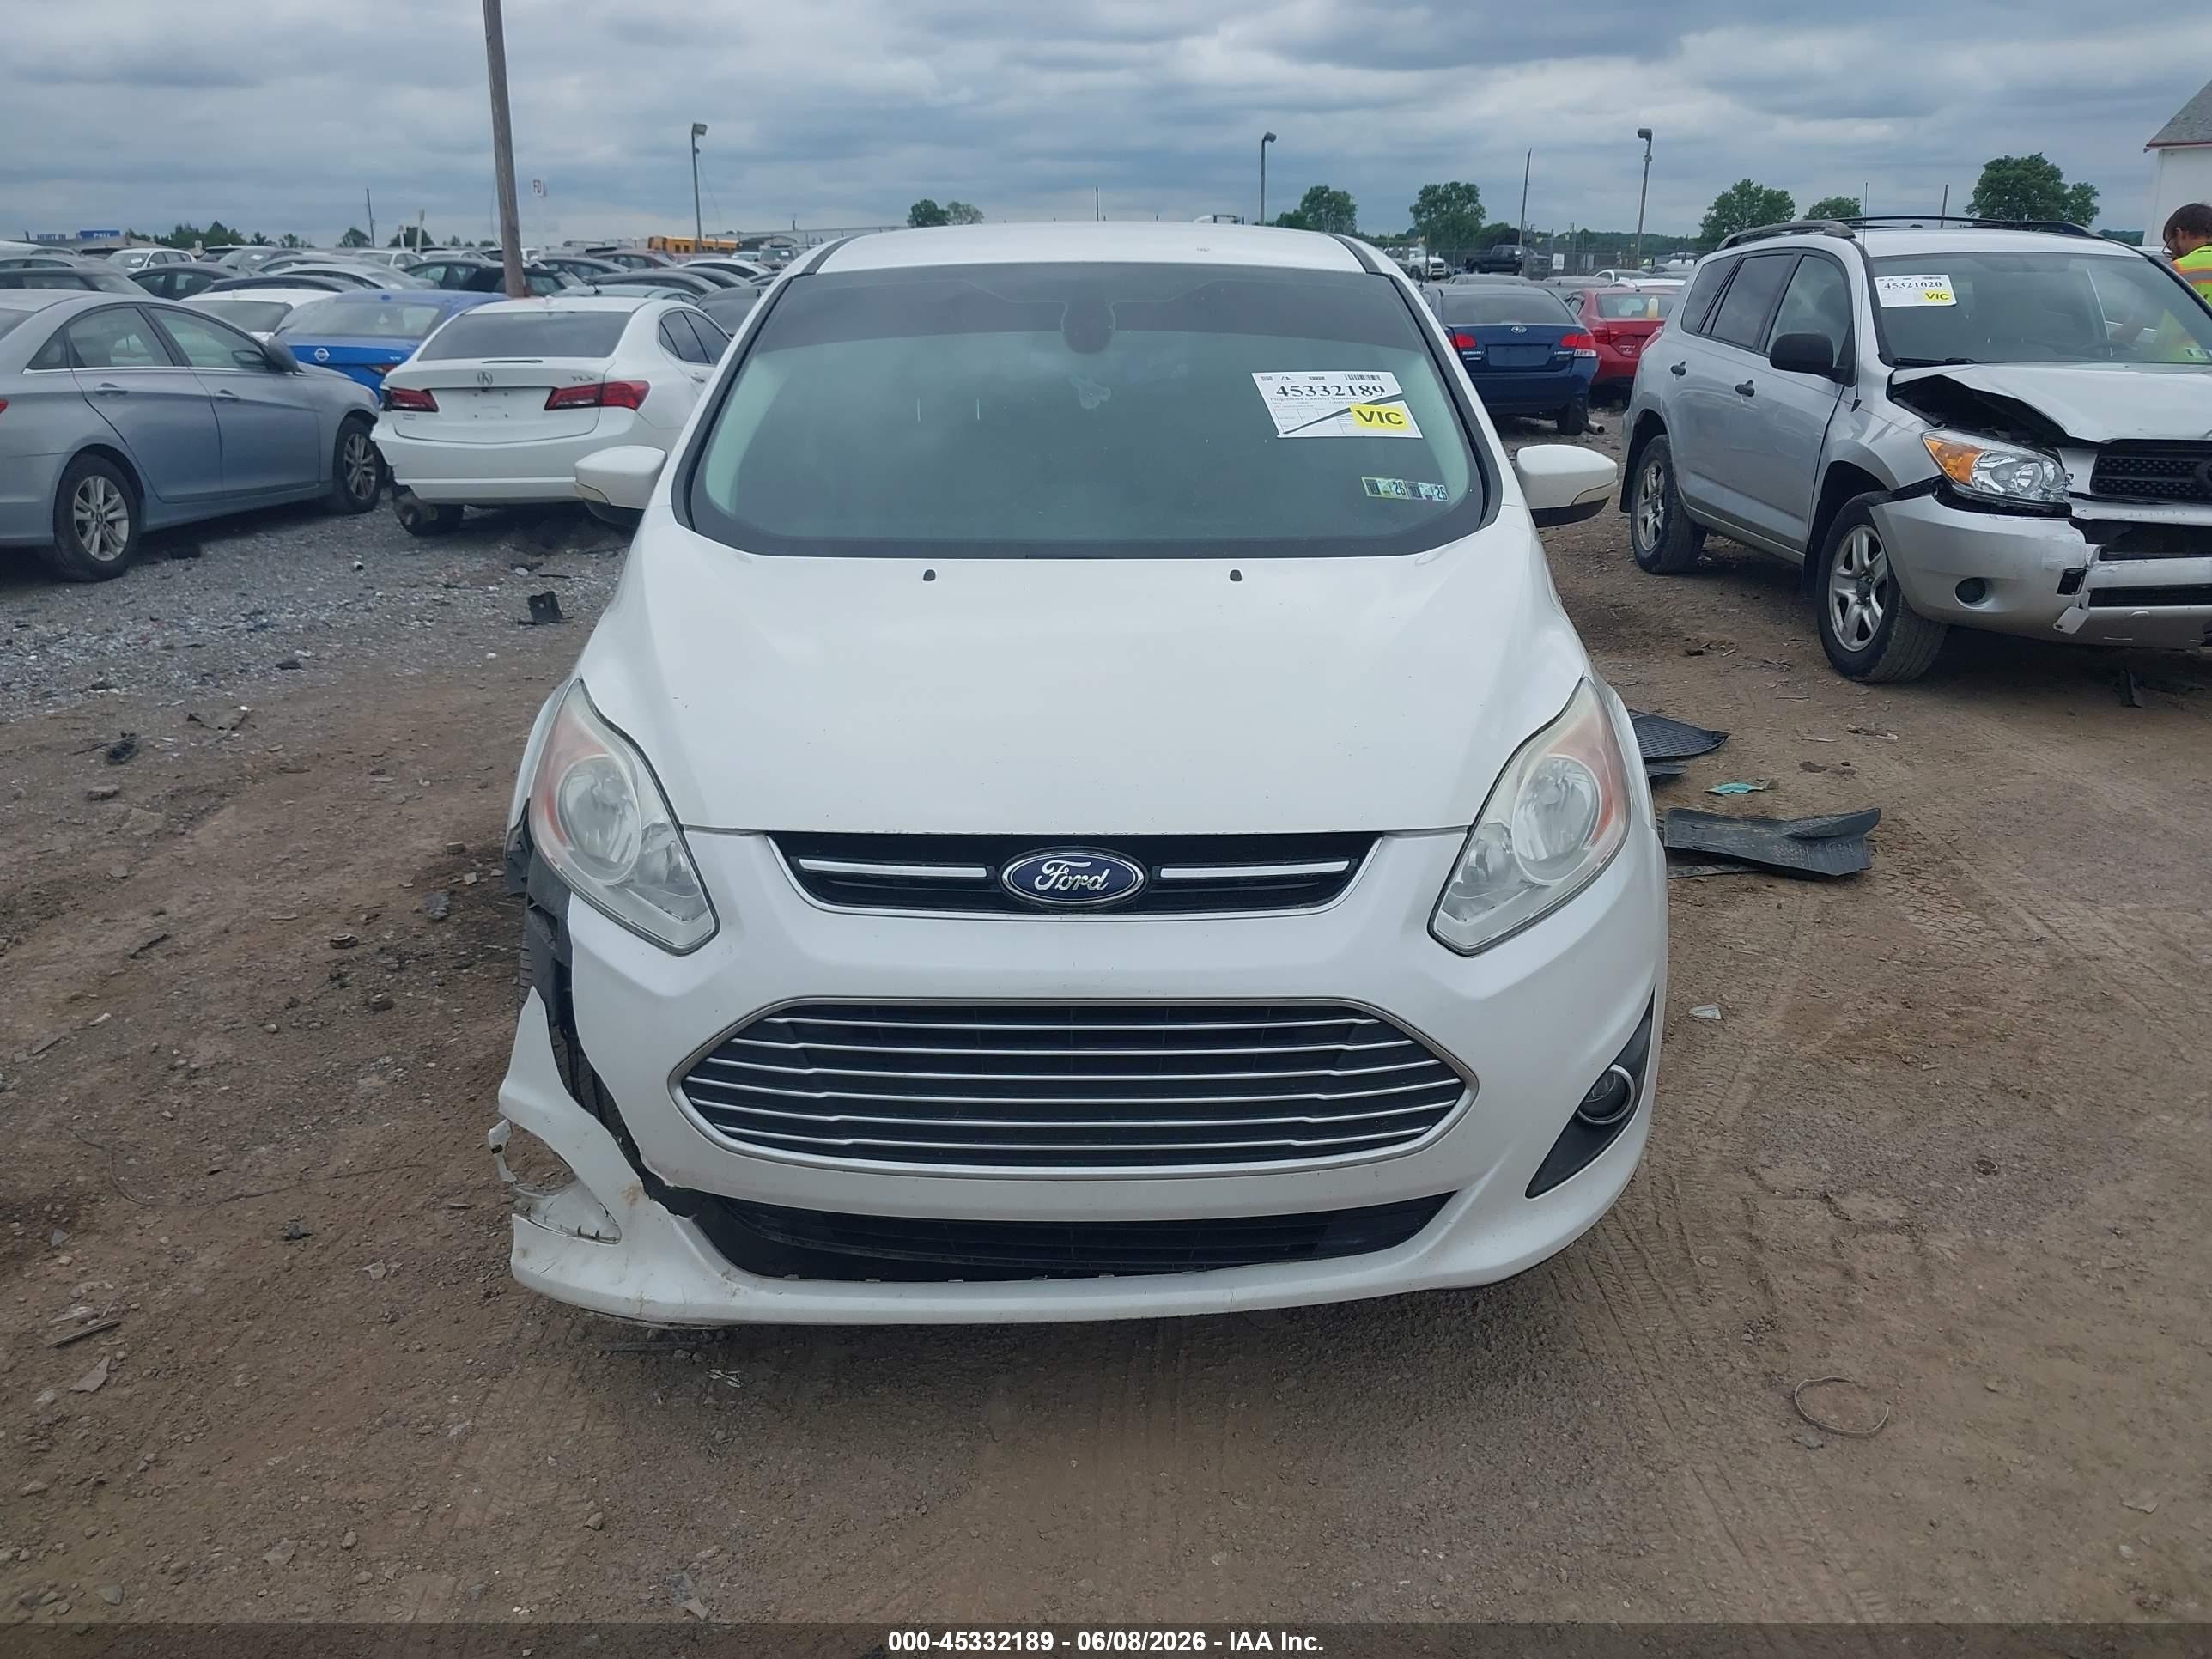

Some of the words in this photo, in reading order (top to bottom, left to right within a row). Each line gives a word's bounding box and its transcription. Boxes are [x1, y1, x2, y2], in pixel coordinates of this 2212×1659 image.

[1884, 281, 1942, 289] 45321020
[1276, 385, 1386, 398] 45332189
[1356, 410, 1404, 426] VIC
[1392, 481, 1407, 495] 26
[1434, 486, 1449, 501] 26
[1034, 860, 1111, 891] Ford
